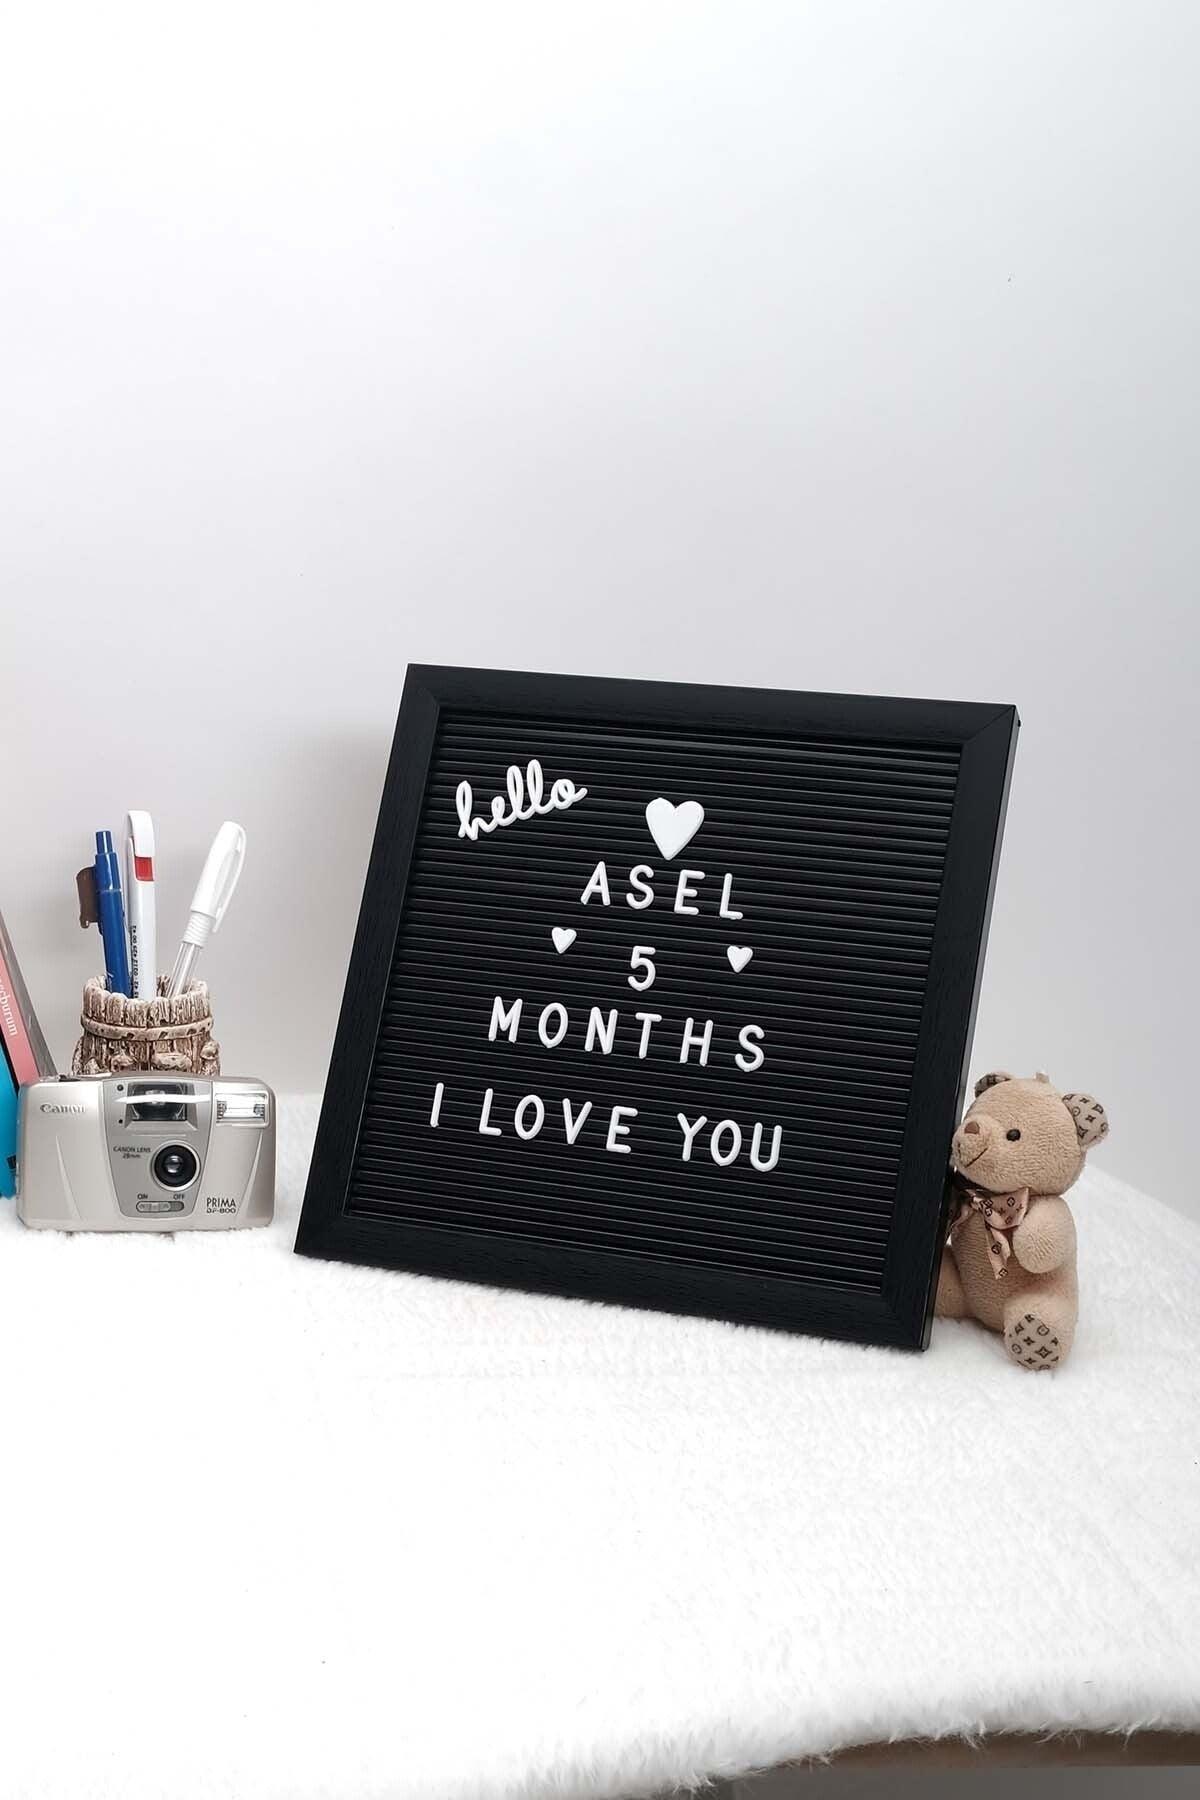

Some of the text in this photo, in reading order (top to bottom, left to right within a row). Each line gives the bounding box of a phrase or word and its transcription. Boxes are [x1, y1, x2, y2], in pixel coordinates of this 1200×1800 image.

[456, 759, 588, 841] hello
[580, 860, 744, 920] ASEL
[627, 945, 657, 992] 5
[488, 995, 765, 1073] MONTHS
[39, 1103, 86, 1114] Canon
[429, 1082, 783, 1173] I LOVE YOU
[206, 1197, 236, 1208] PRIMA
